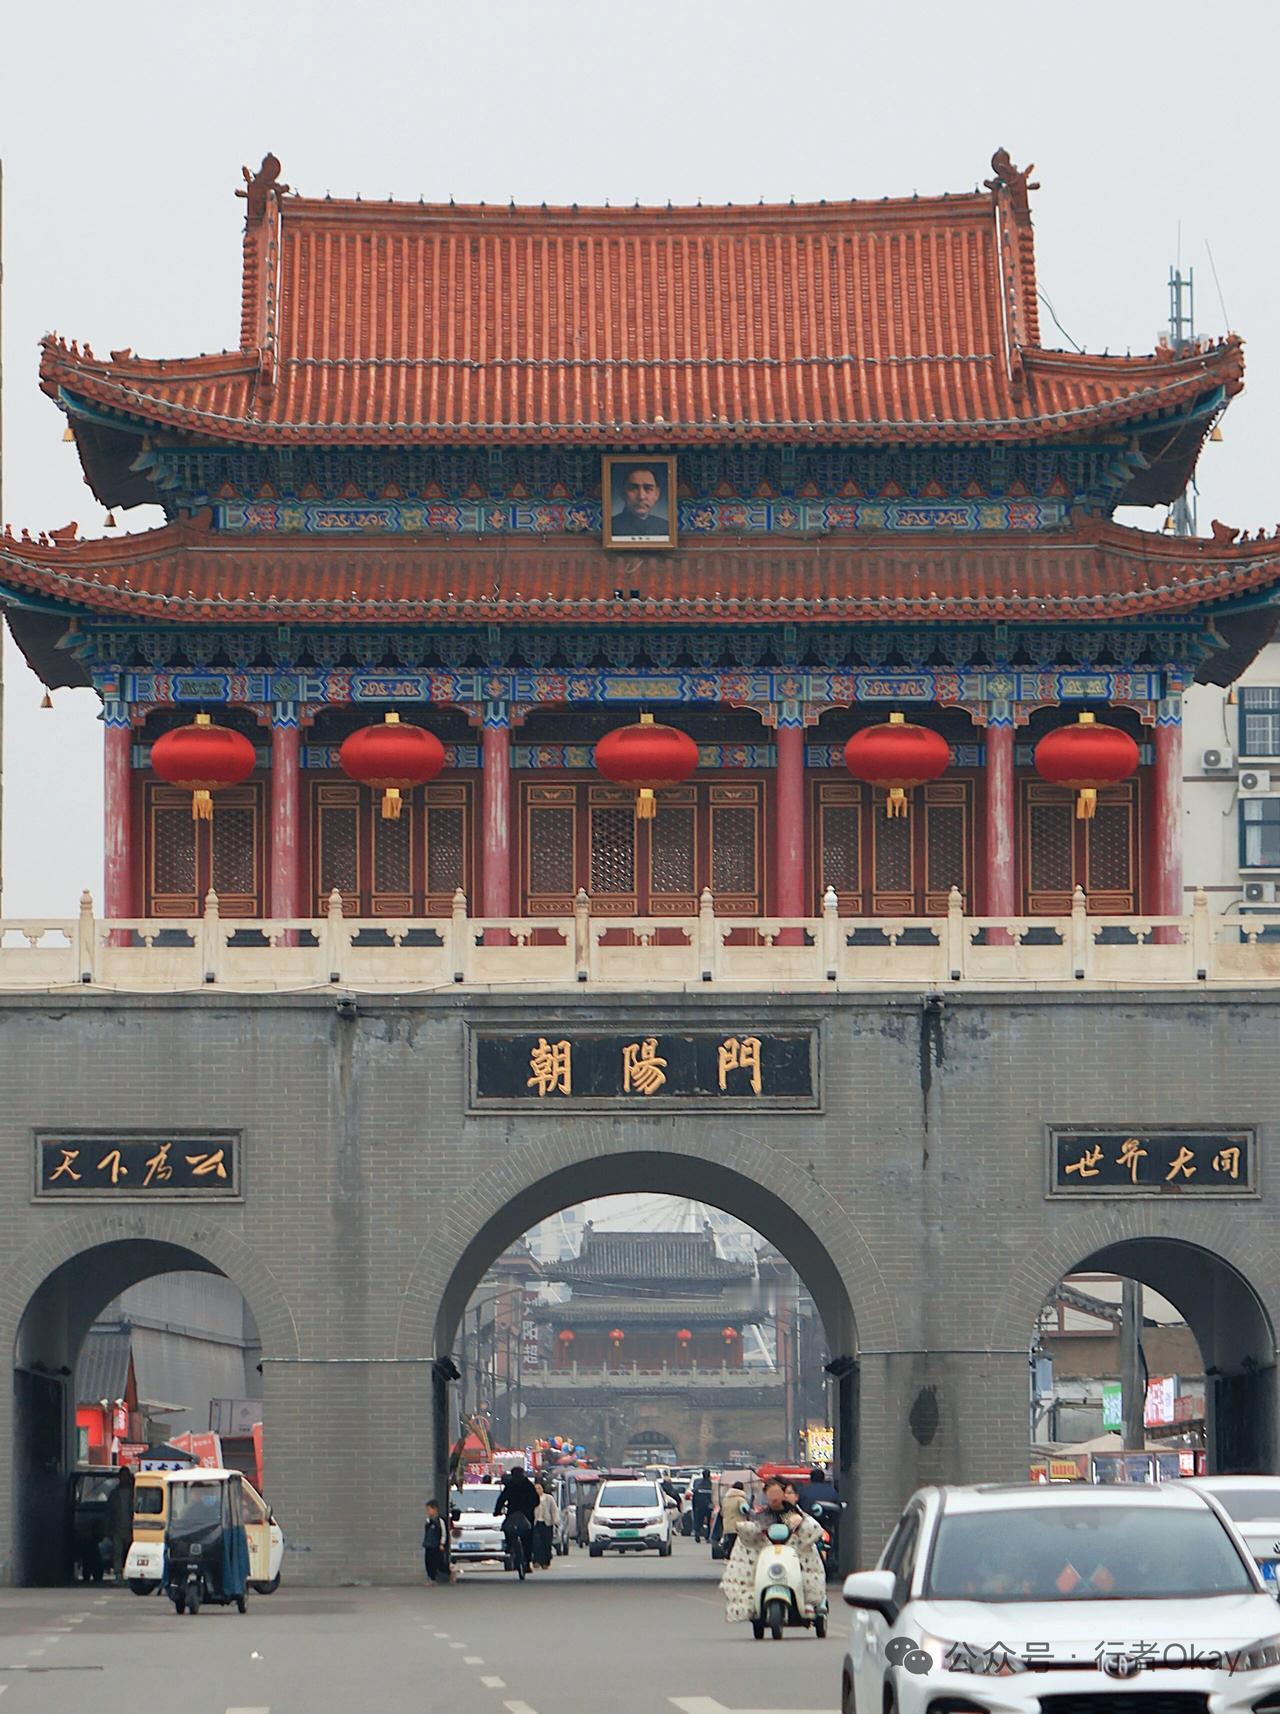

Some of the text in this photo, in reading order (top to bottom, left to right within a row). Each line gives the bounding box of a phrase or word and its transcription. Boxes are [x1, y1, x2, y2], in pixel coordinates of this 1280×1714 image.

[527, 1036, 763, 1096] 朝陽門
[1064, 1138, 1241, 1184] 世界大同
